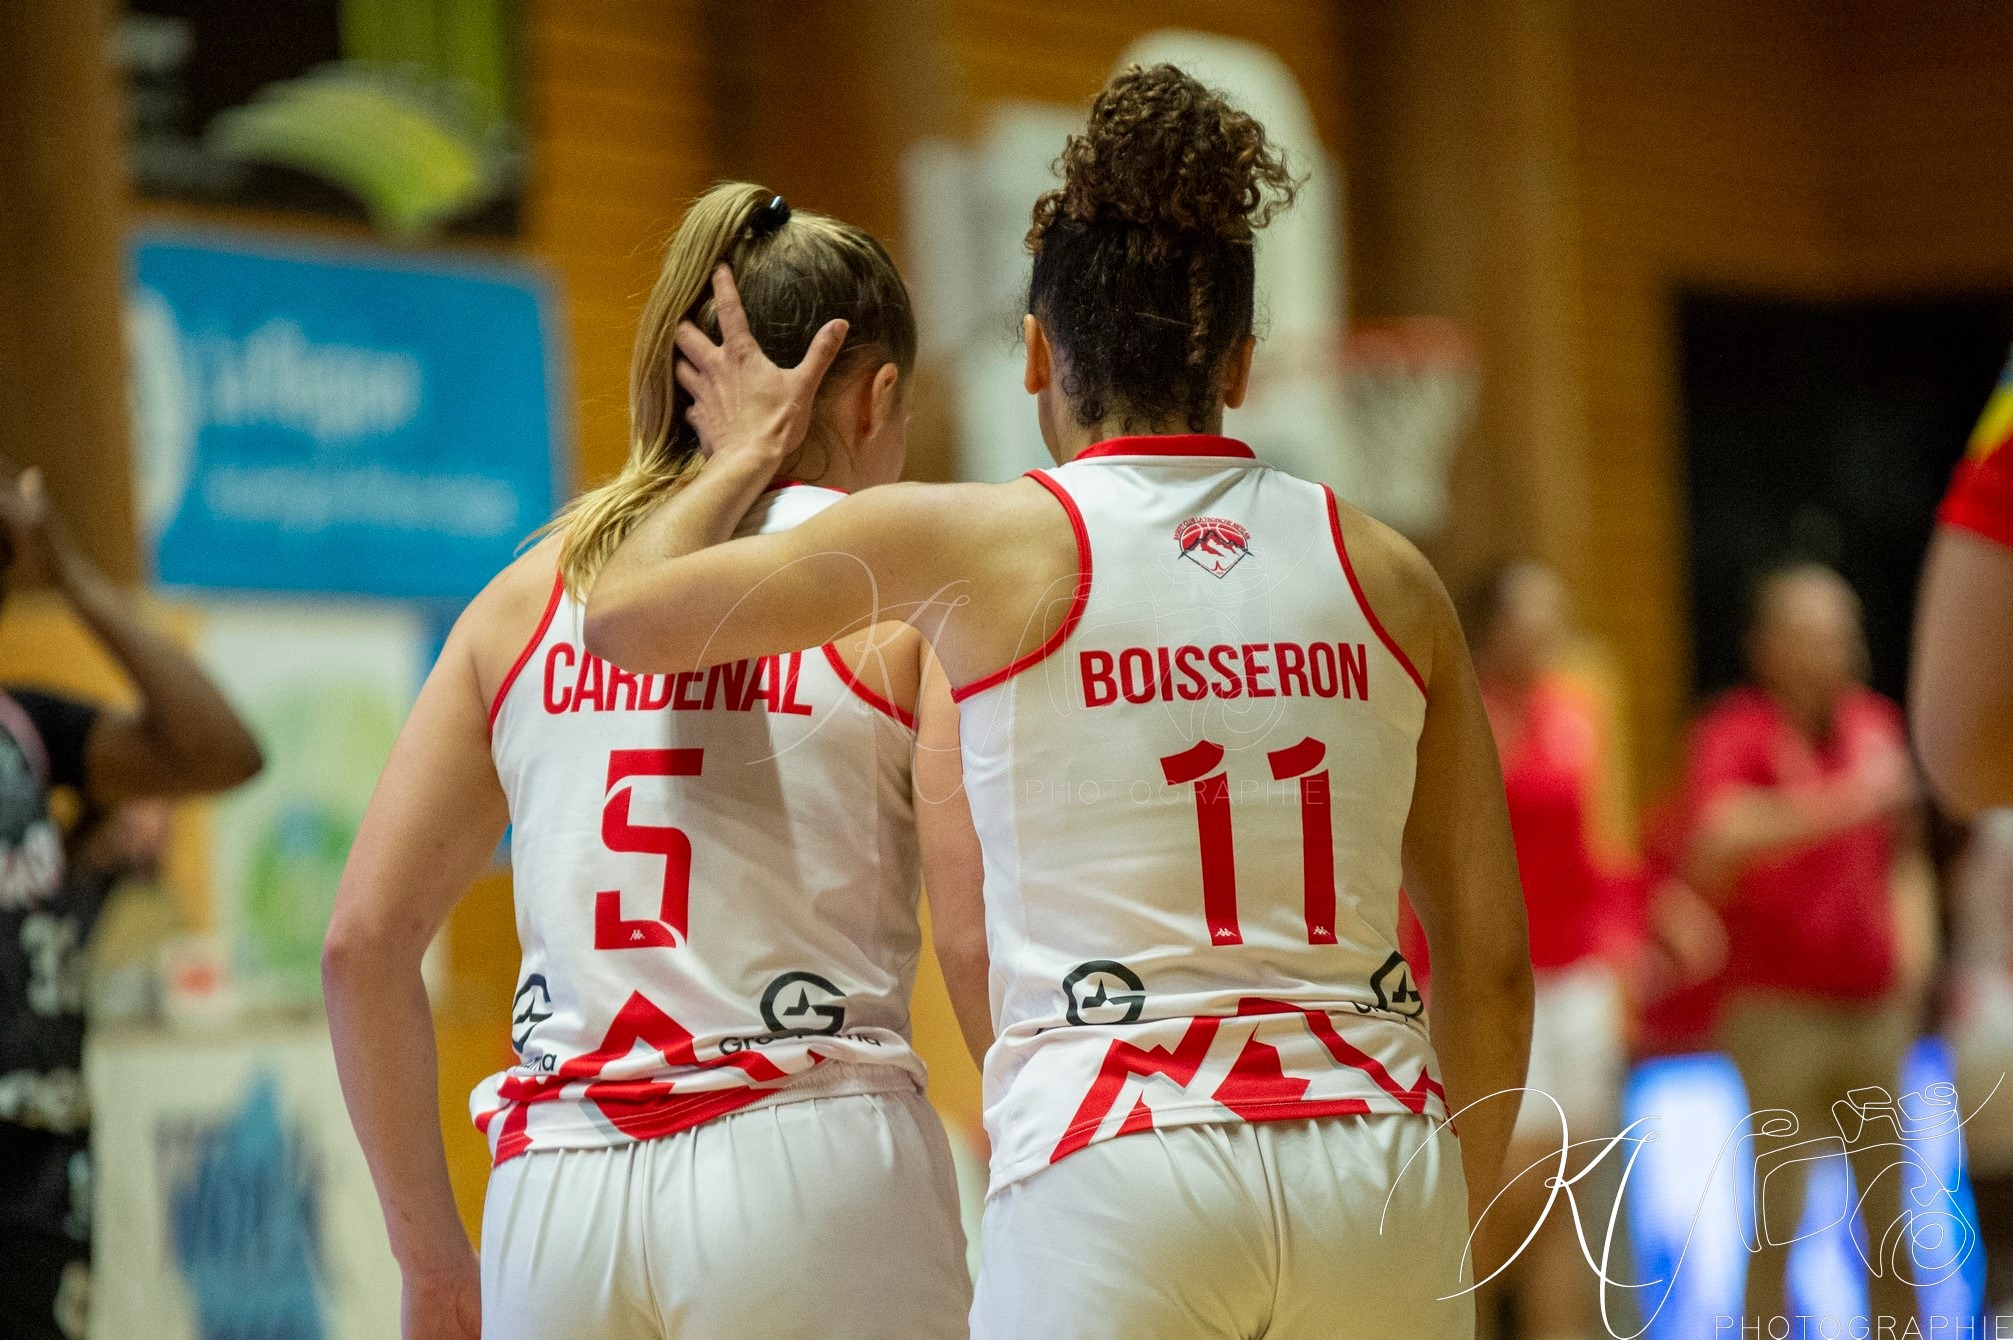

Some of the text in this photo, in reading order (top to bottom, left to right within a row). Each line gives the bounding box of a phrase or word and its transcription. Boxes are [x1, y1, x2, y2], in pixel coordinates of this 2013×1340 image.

[1079, 641, 1369, 708] BOISSERON
[594, 748, 704, 950] 5
[1159, 736, 1339, 947] 11
